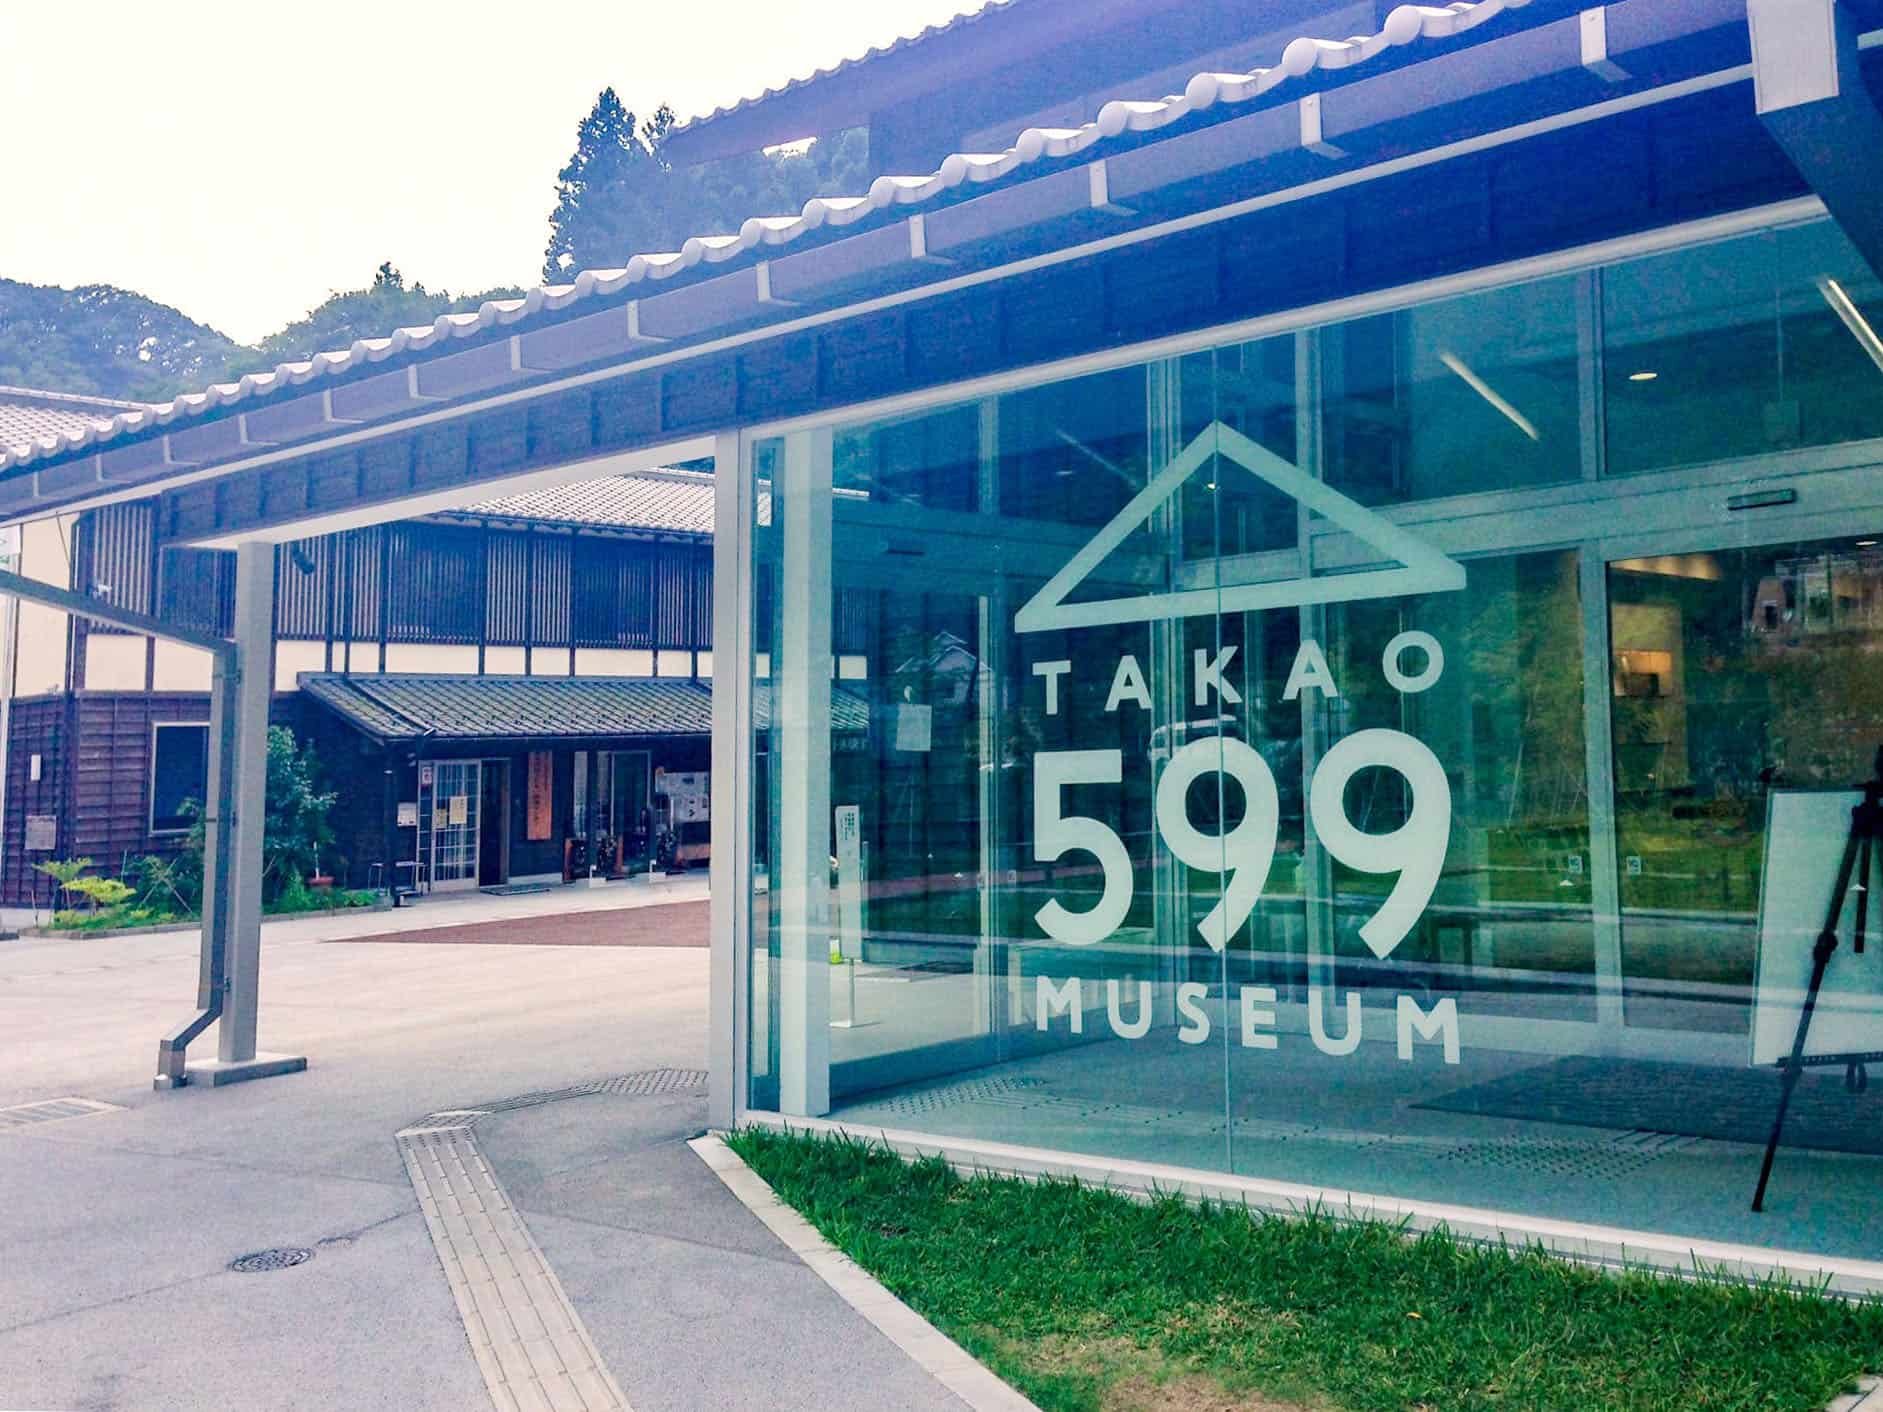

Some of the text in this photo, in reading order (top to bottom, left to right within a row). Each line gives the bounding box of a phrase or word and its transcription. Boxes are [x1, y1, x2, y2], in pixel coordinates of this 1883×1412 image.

[1032, 630, 1445, 715] TAKAO
[1034, 728, 1452, 960] 599
[1036, 975, 1461, 1065] MUSEUM
